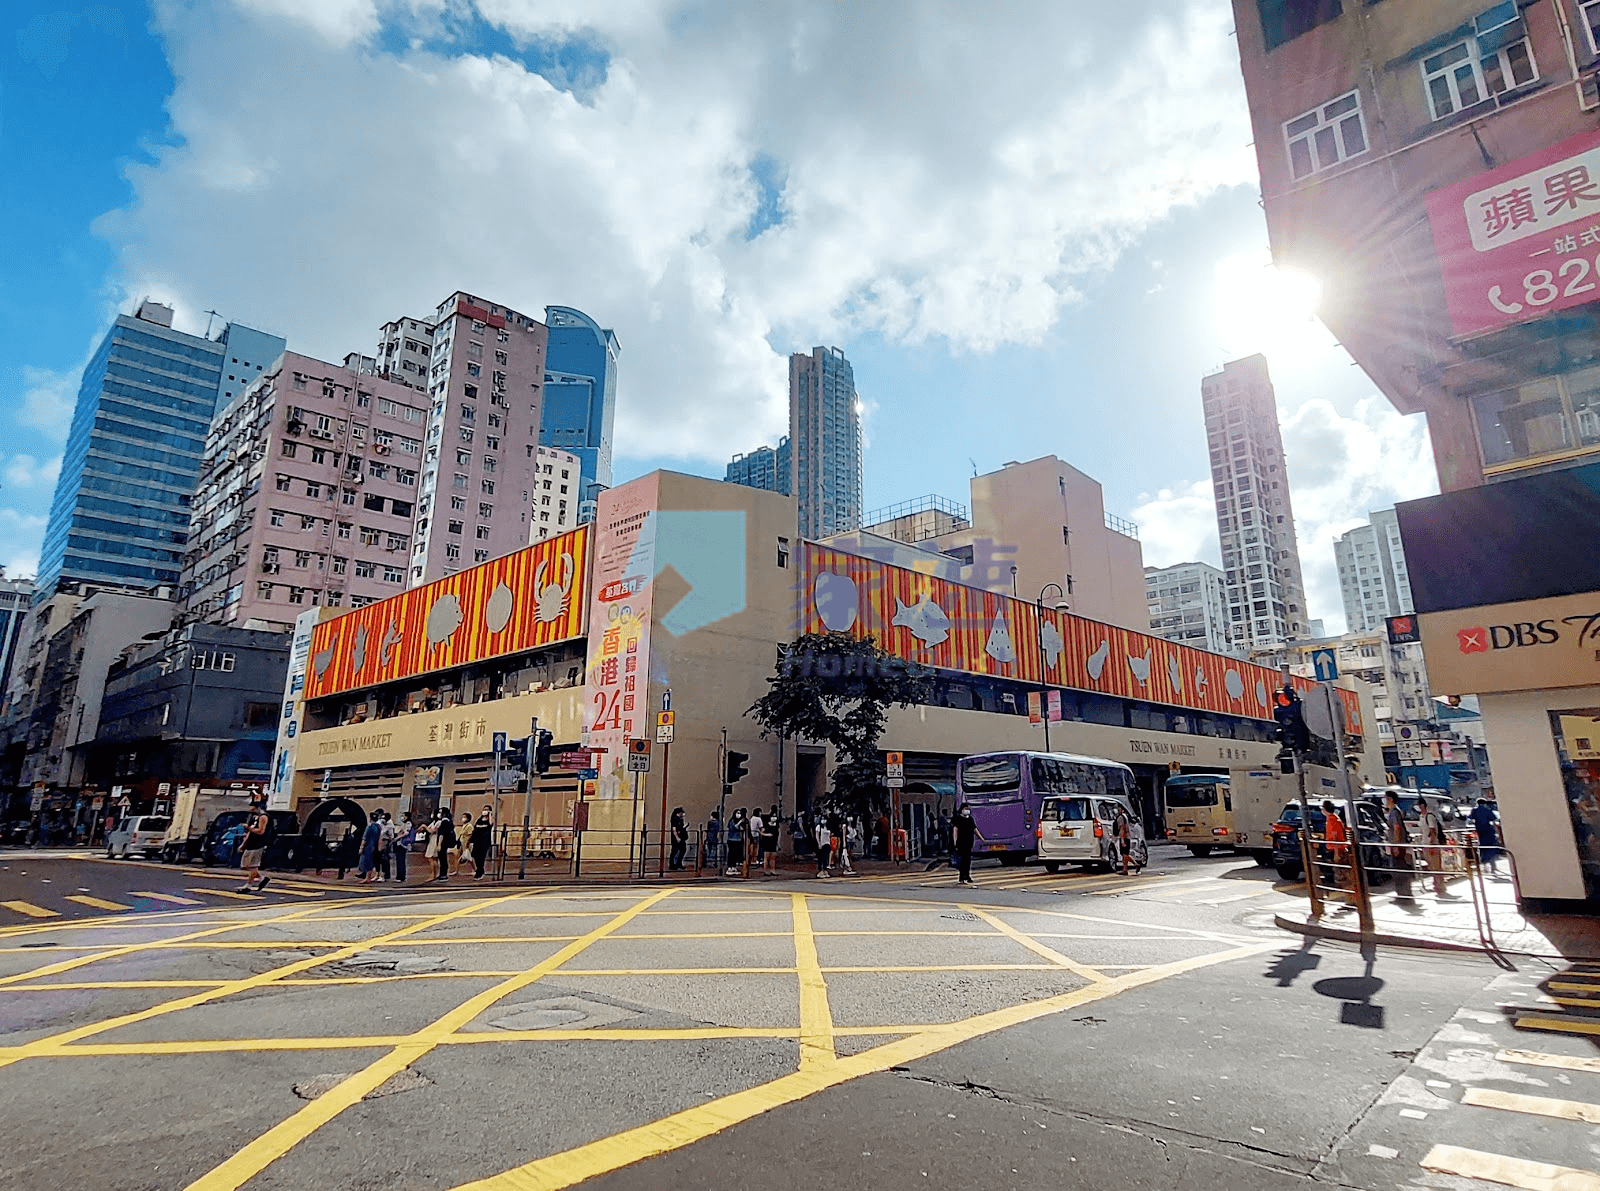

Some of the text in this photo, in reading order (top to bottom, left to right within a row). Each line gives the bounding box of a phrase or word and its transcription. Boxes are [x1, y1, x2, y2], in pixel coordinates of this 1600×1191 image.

[1480, 165, 1600, 239] 蘋果
[1523, 252, 1600, 306] 82
[1489, 612, 1600, 650] DBS T
[600, 626, 621, 687] 香港
[428, 717, 488, 743] 荃灣街市
[591, 688, 623, 732] 24
[318, 732, 393, 756] TSUEN WAN MARKET
[1129, 740, 1196, 757] TSUEN WAN MARKET
